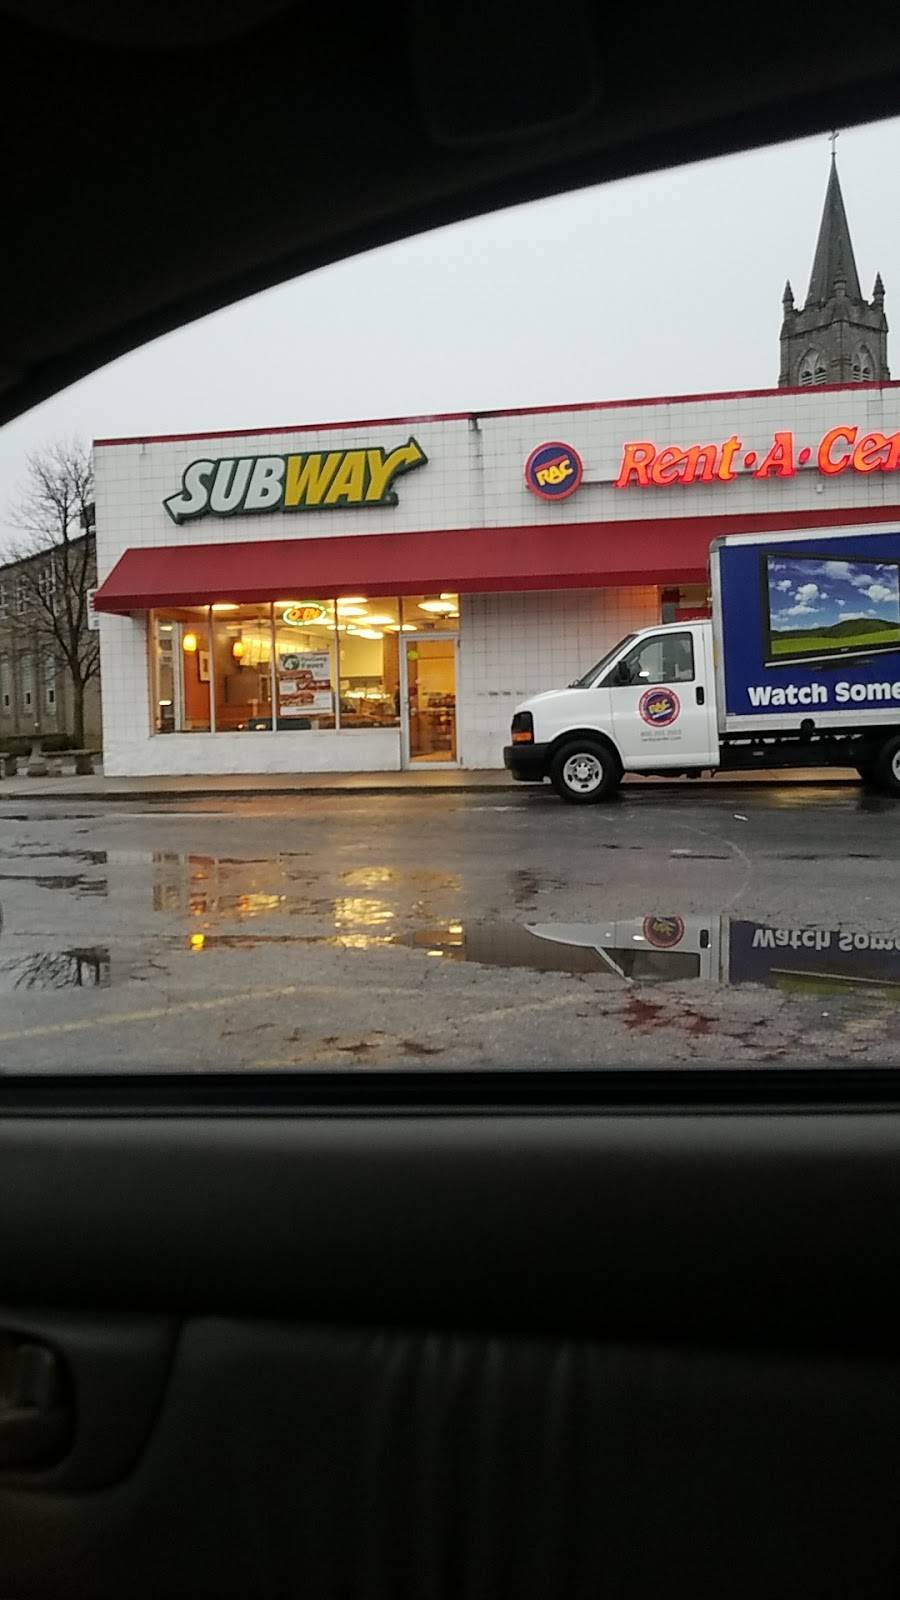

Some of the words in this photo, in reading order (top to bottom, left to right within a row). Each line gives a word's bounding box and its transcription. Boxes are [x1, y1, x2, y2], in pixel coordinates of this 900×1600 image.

[166, 442, 421, 515] SUBWAY
[536, 459, 574, 486] RAC
[748, 684, 828, 706] Watch
